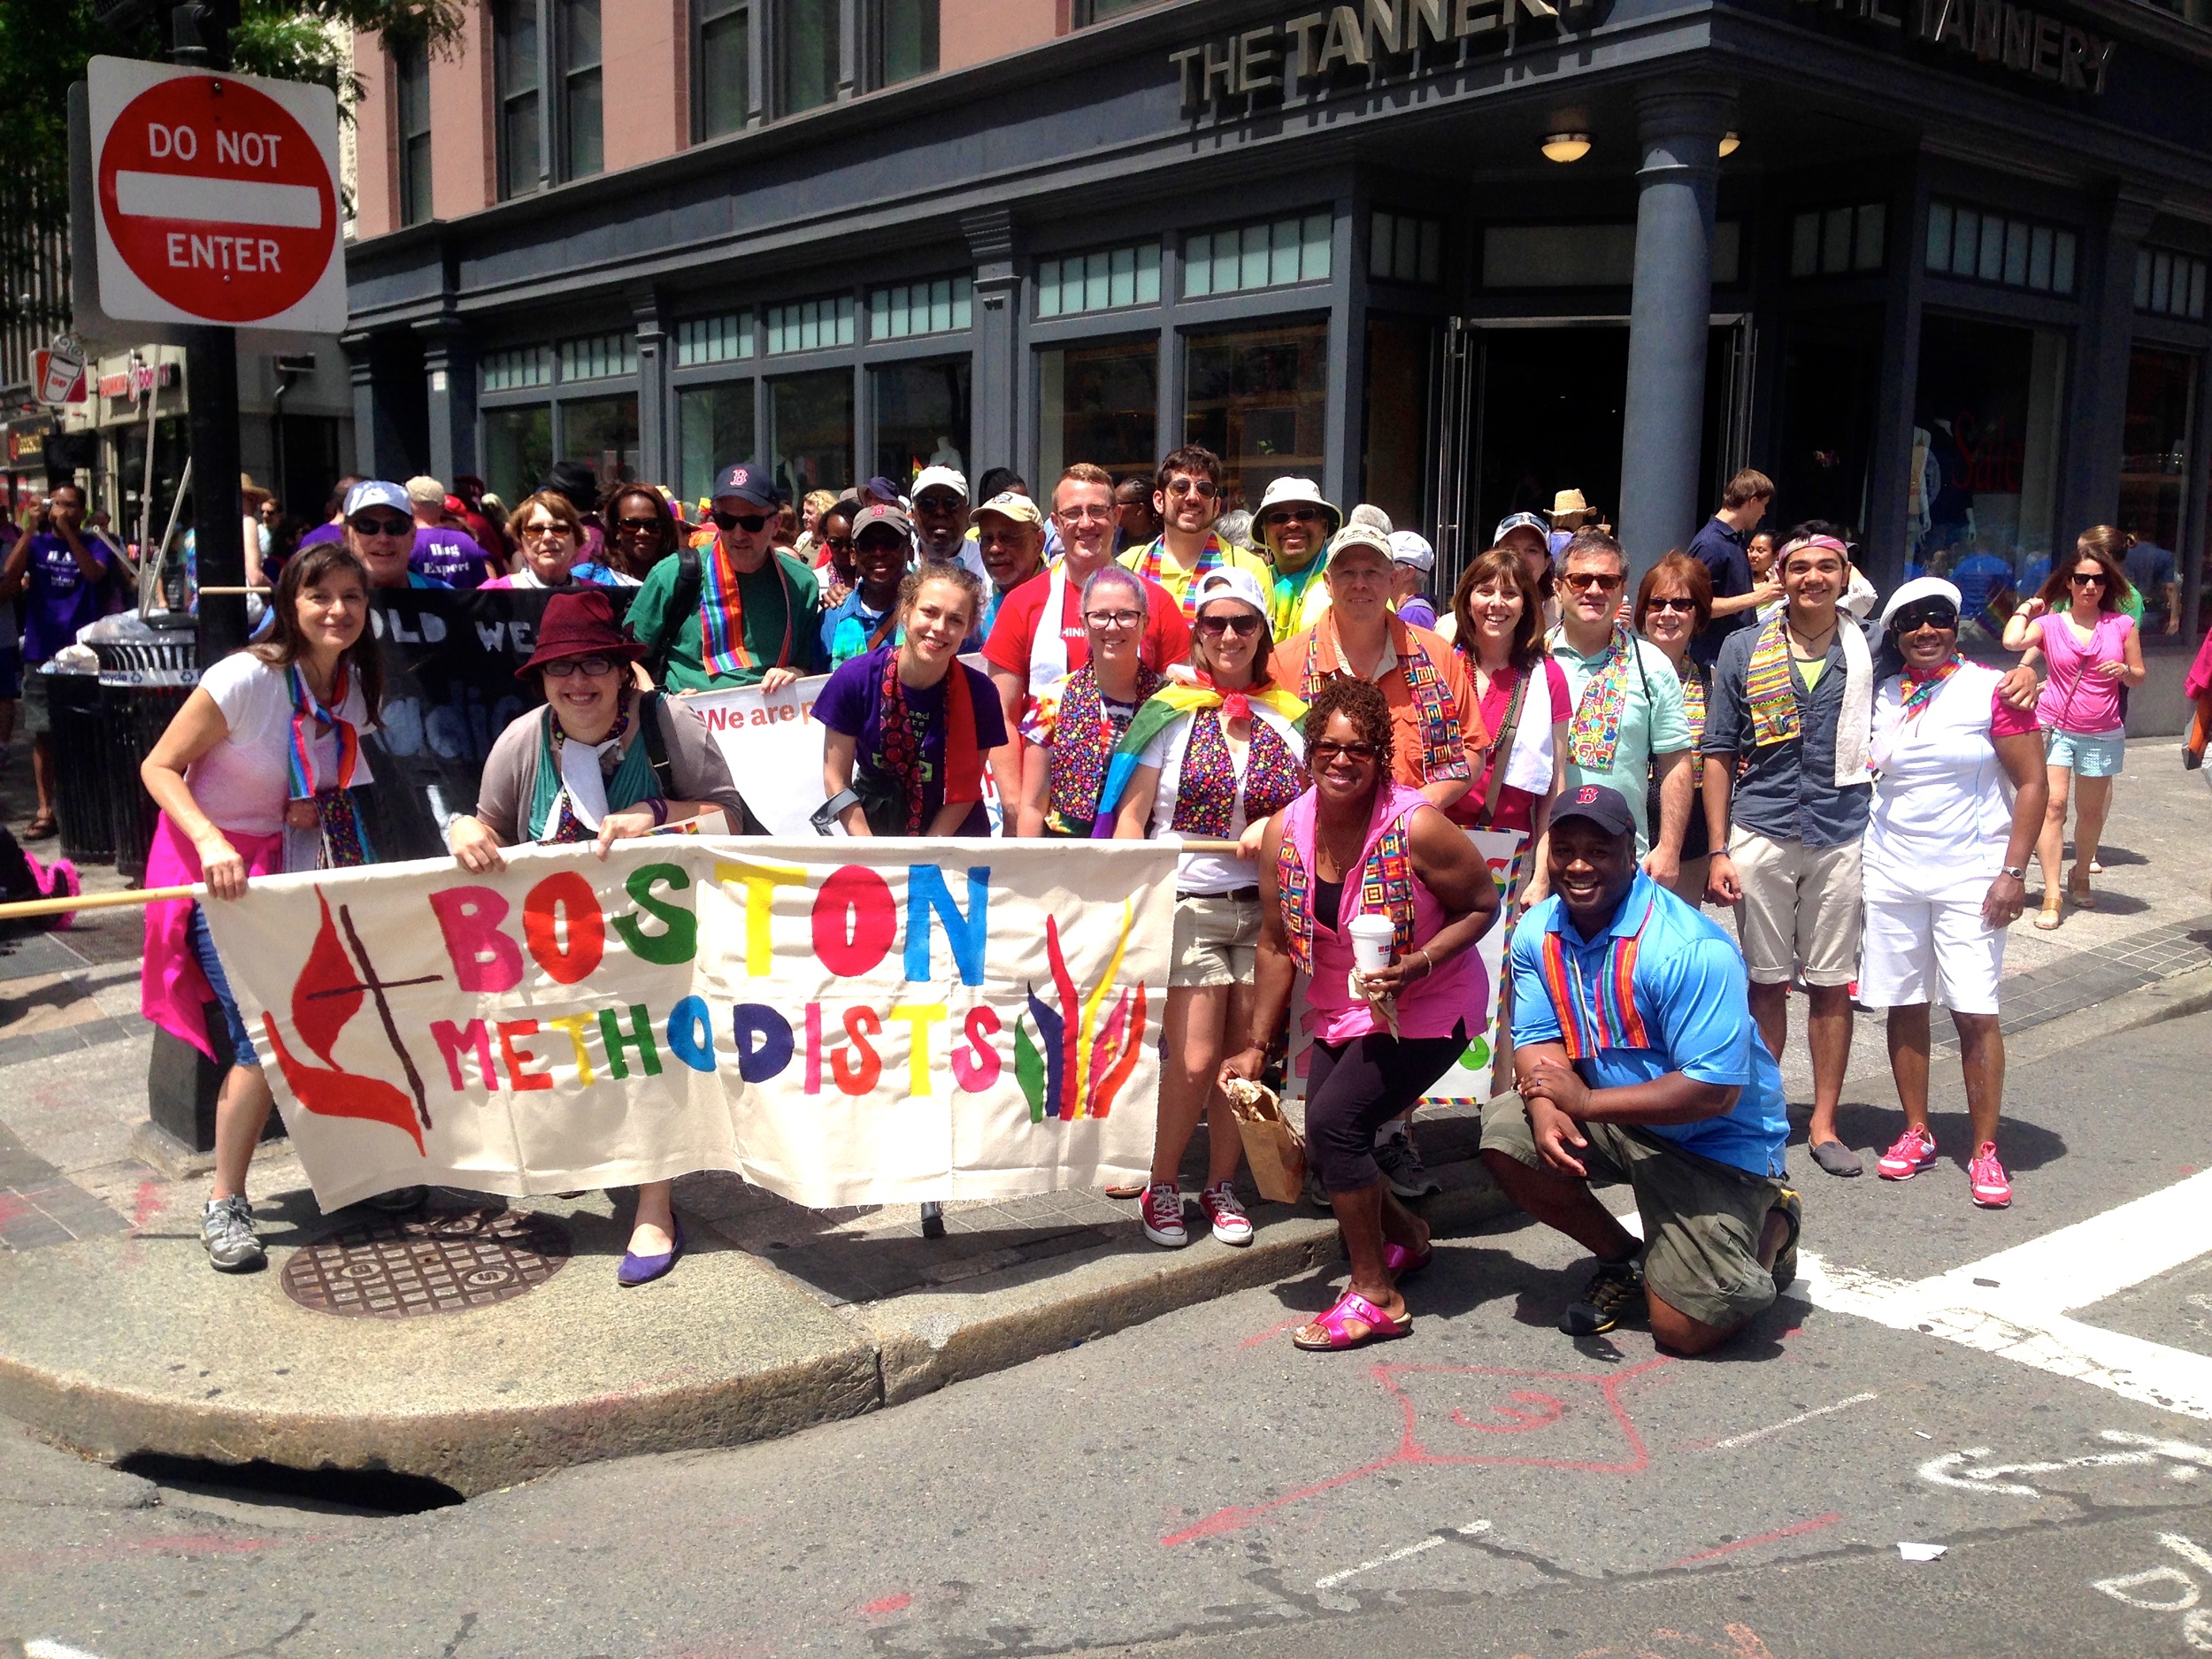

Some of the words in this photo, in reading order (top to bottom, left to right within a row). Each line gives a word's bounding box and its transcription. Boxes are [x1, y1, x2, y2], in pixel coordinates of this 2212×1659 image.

[1168, 24, 1283, 107] THE
[1285, 0, 1581, 77] TANNE
[148, 122, 198, 161] DO
[216, 129, 283, 168] NOT
[166, 232, 281, 273] ENTER
[1951, 410, 2025, 493] Sale
[729, 468, 749, 486] B
[423, 561, 471, 577] Expert
[430, 542, 460, 557] Hug
[696, 707, 745, 733] We
[749, 703, 795, 726] are
[1575, 785, 1600, 804] B
[429, 862, 992, 993] BOSTON
[430, 994, 1002, 1097] METHODISTS
